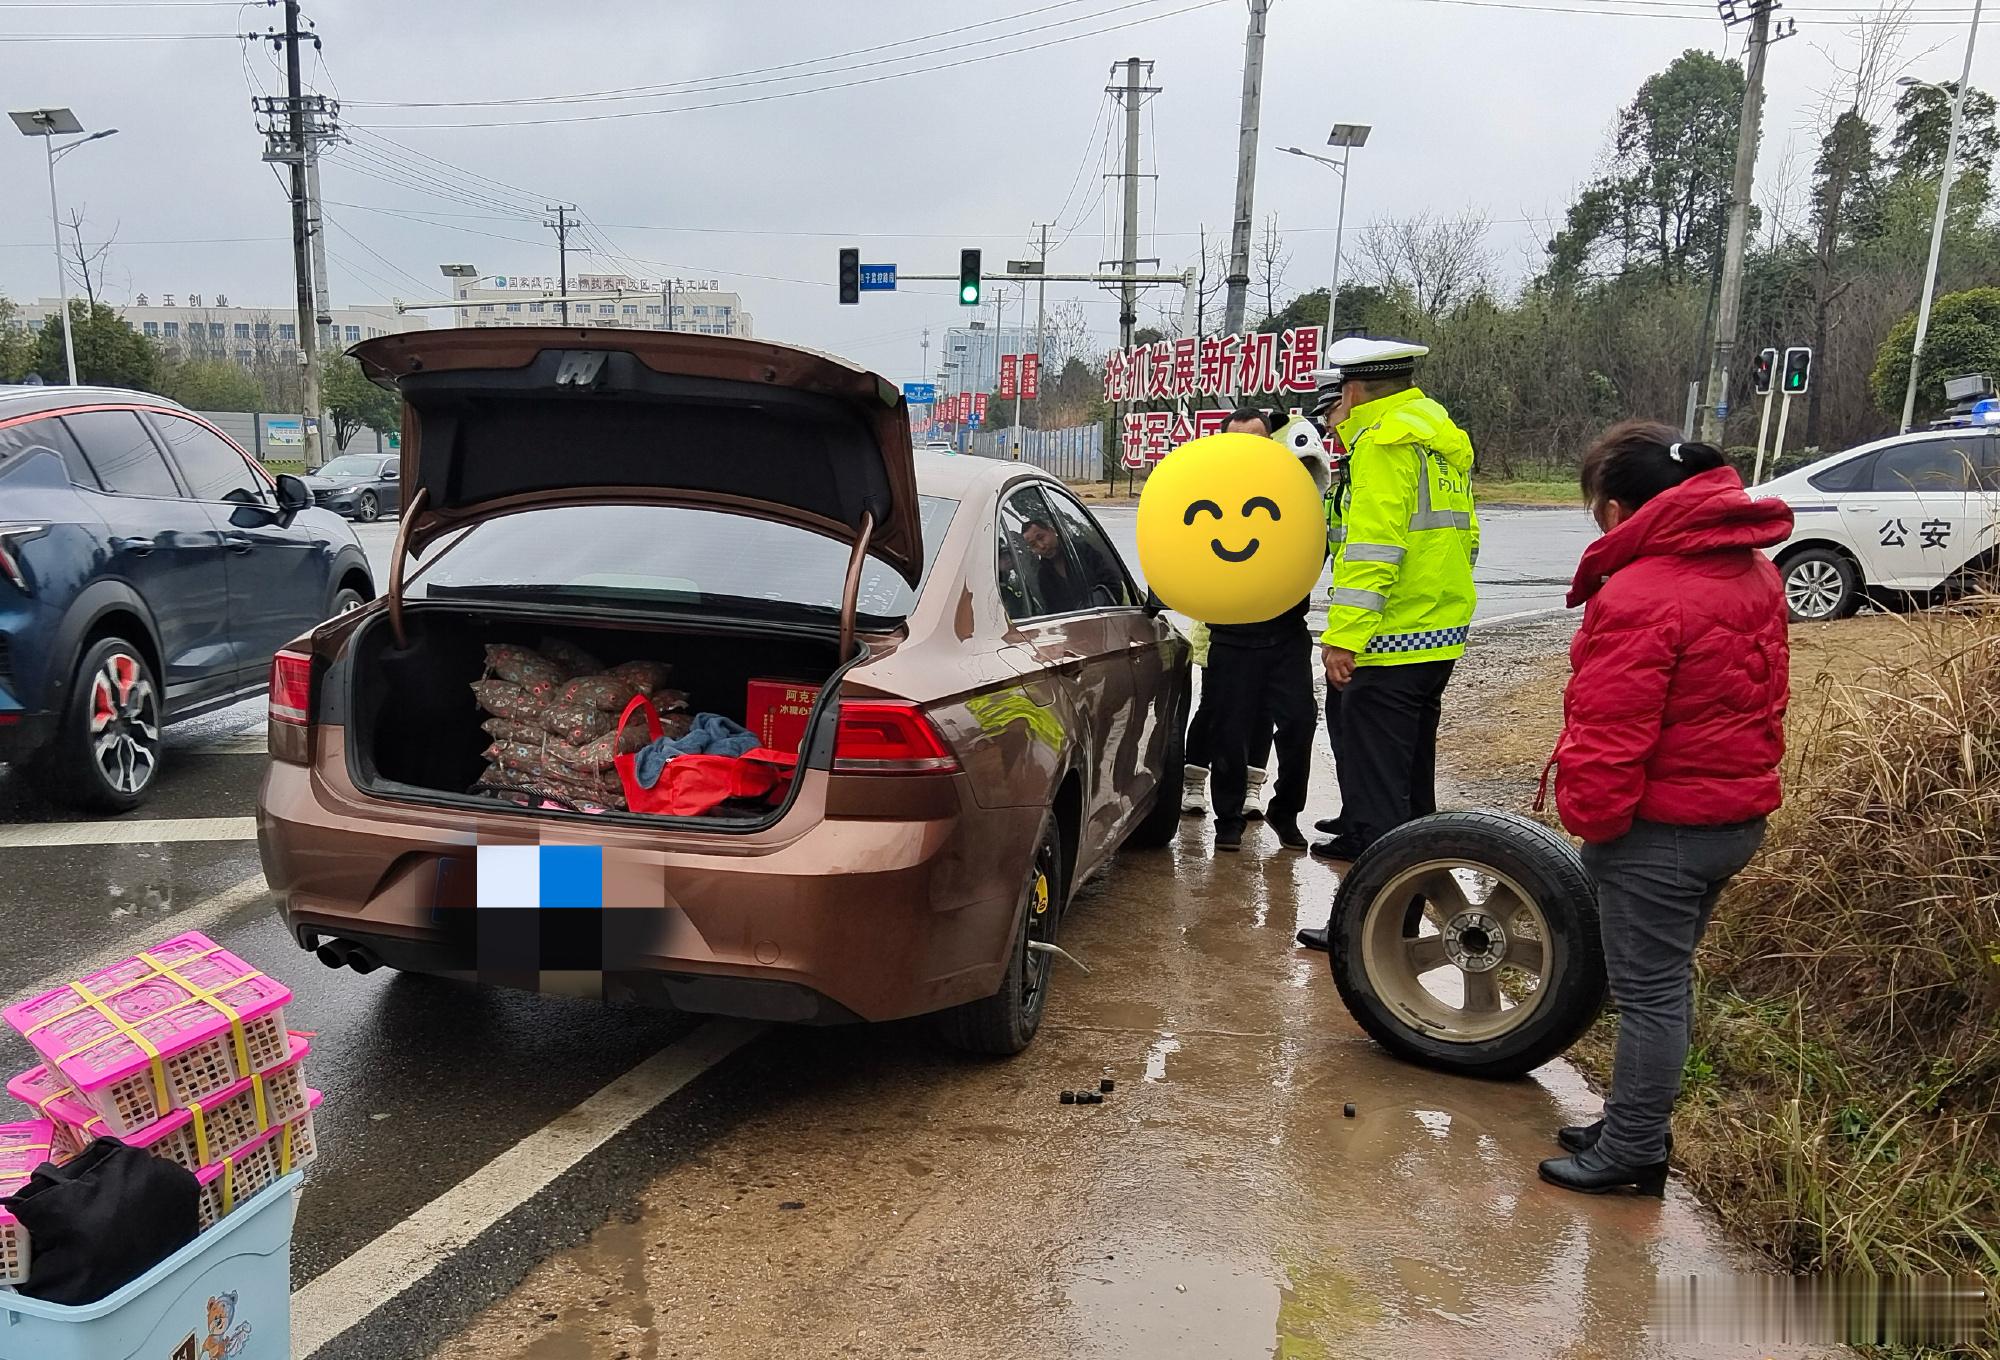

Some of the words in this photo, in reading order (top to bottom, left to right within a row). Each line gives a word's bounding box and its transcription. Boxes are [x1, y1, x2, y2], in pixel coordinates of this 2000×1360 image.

[136, 292, 229, 308] 金玉创业
[1103, 325, 1324, 403] 抢抓发展新机遇
[1879, 518, 1951, 549] 公安
